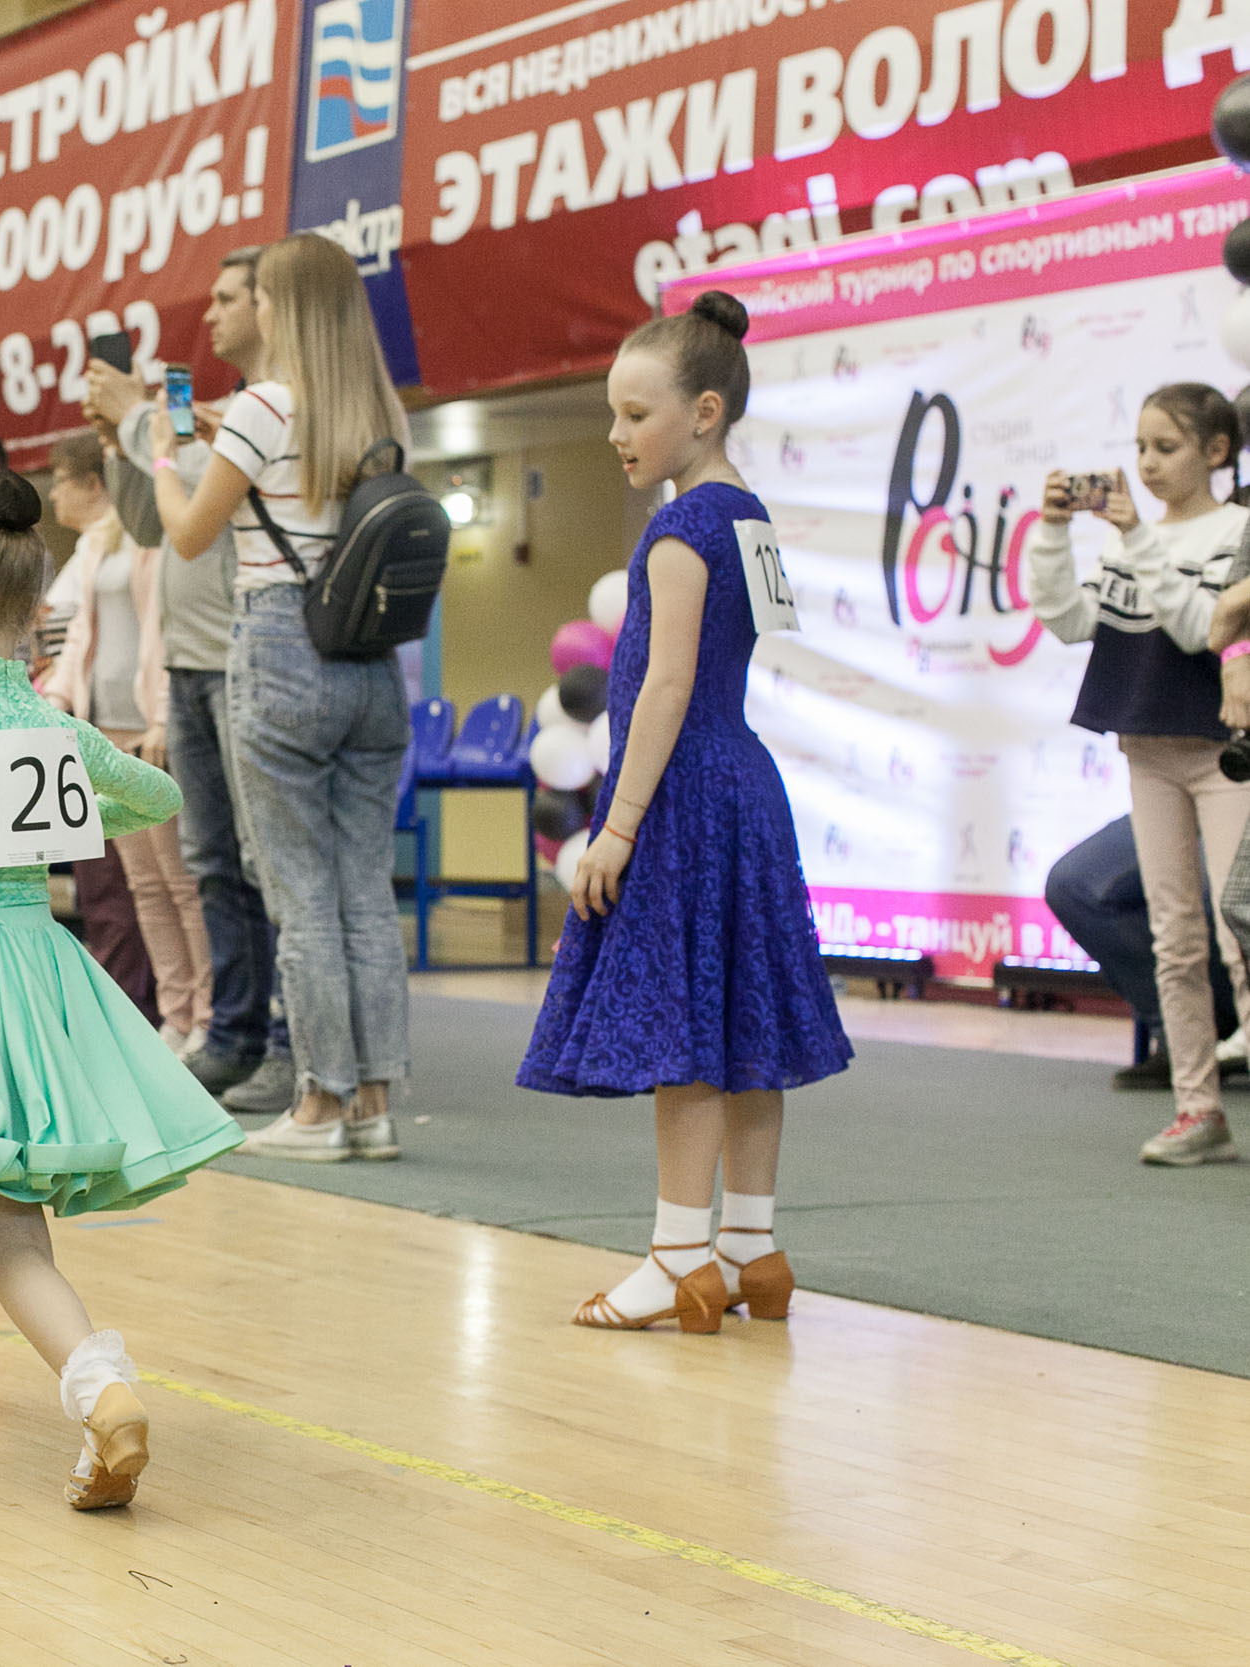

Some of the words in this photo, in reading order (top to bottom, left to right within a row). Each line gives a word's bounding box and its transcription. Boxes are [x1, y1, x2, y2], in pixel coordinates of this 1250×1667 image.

[439, 62, 511, 122] ВСЯ
[511, 0, 842, 100] НЕДВИЖИМО
[103, 126, 269, 283] руб.!
[431, 67, 757, 245] ЭТАЖИ
[939, 248, 976, 283] по
[979, 212, 1174, 276] спортивным
[893, 912, 1013, 963] танцуй
